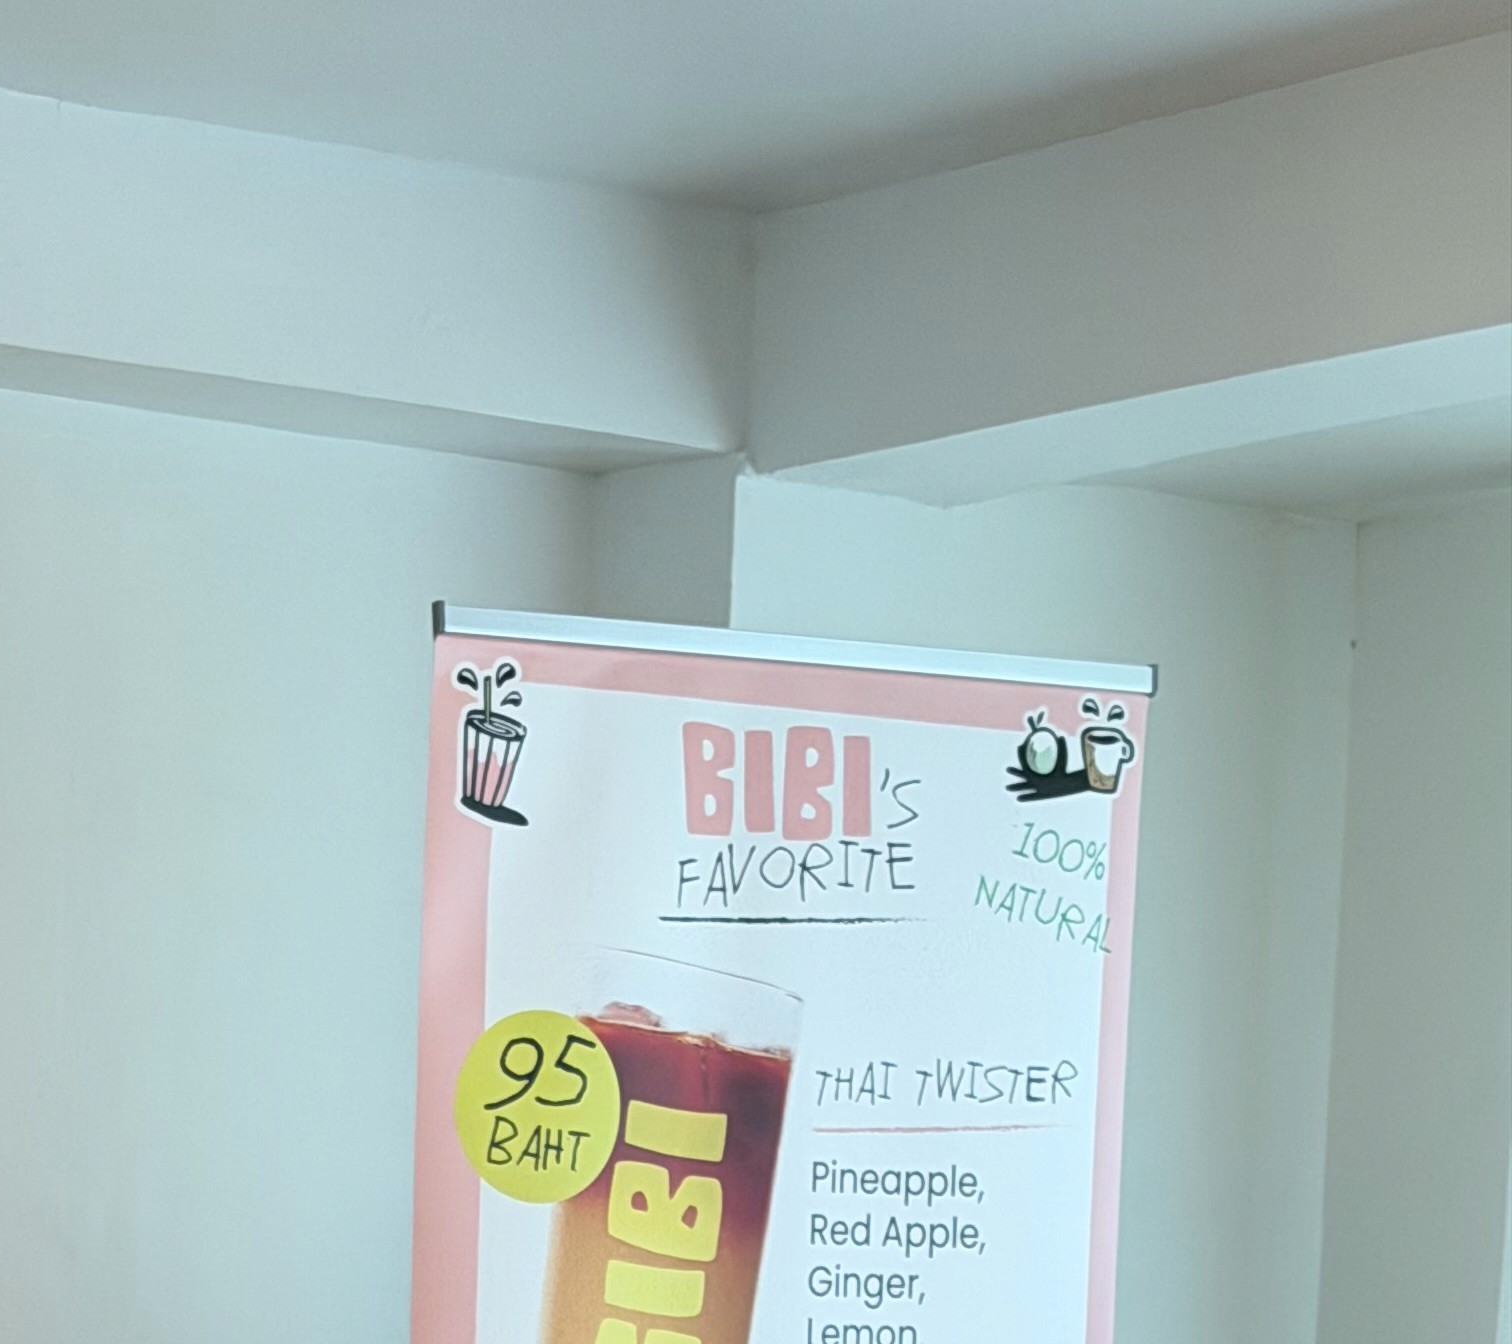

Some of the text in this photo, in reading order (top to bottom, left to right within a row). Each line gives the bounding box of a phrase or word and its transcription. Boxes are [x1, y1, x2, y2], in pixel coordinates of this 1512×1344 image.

[677, 841, 916, 908] FAVORITE
[1013, 821, 1107, 881] 100%
[976, 875, 1112, 954] NATURAL
[483, 1035, 596, 1110] 95
[815, 1059, 1079, 1105] THAI TWISTER
[488, 1116, 591, 1172] BAHT
[811, 1160, 986, 1204] Pineapple,
[810, 1212, 987, 1256] Red Apple,
[807, 1264, 926, 1309] Ginger,
